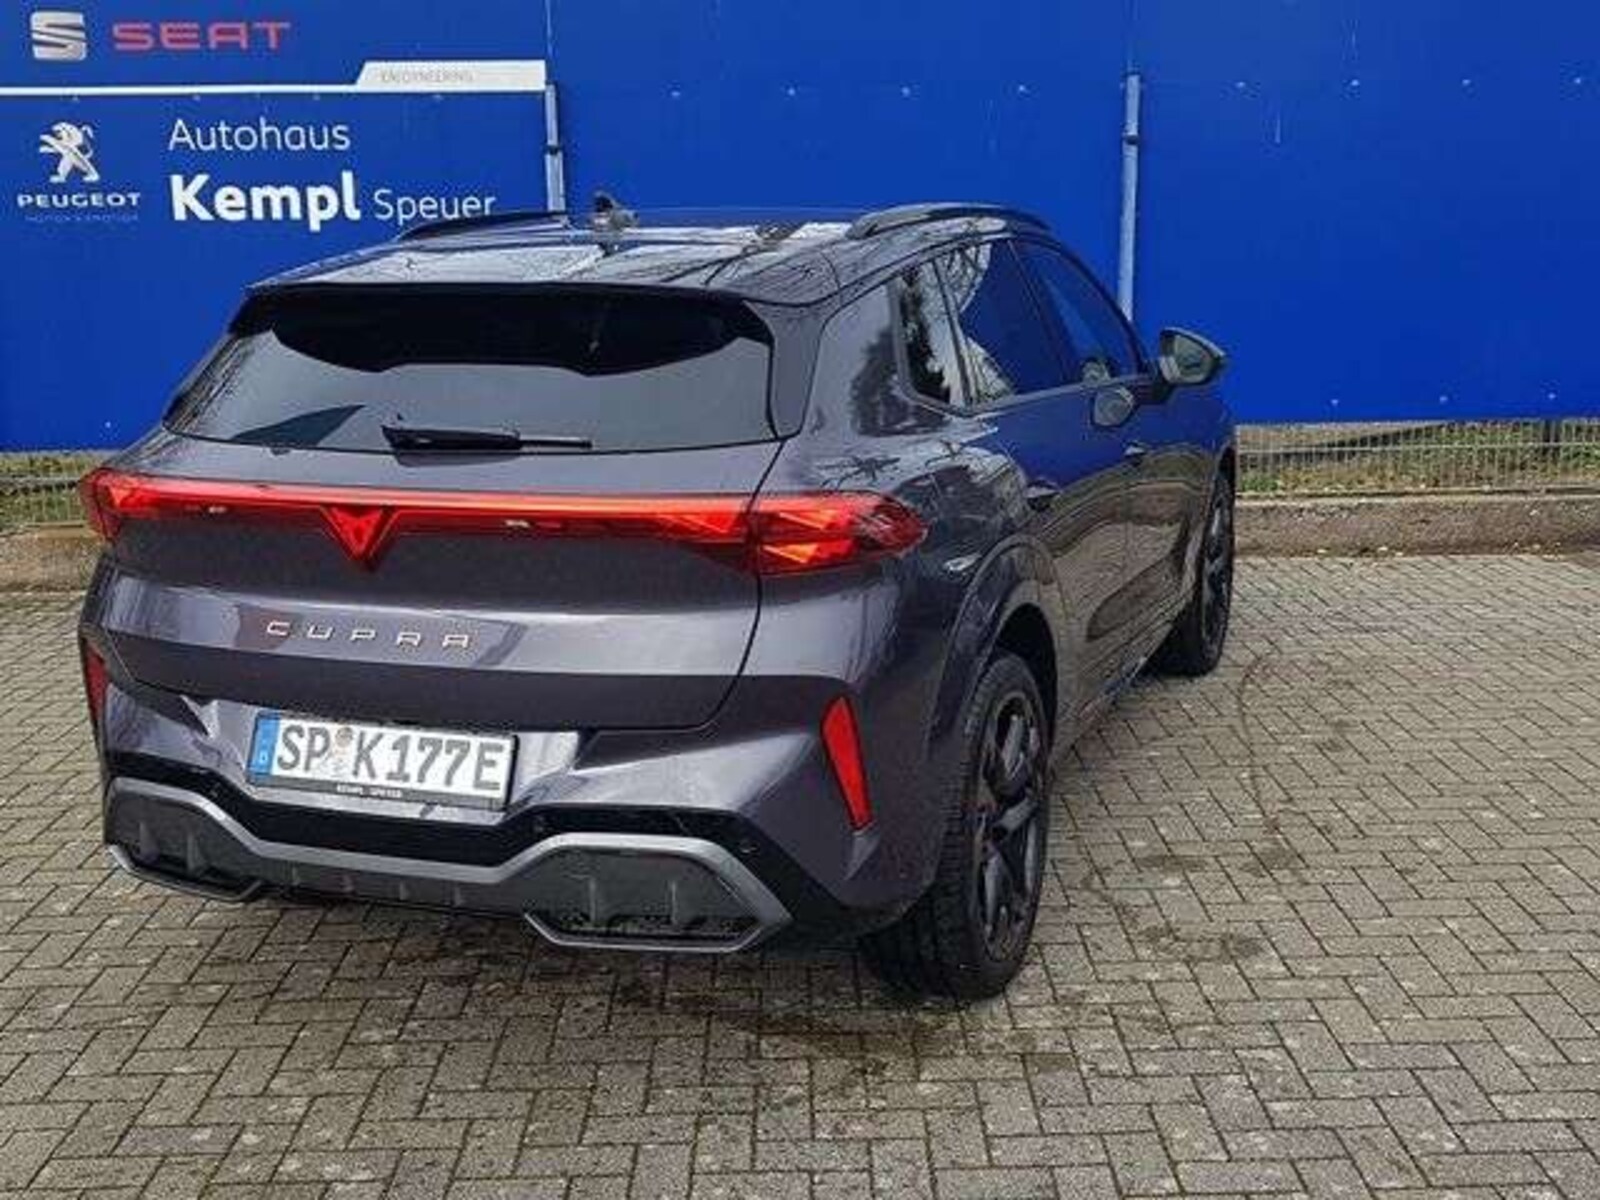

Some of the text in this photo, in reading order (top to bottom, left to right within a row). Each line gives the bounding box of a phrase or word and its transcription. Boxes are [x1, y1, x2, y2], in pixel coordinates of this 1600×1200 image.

[112, 22, 291, 51] SEAT
[168, 116, 351, 152] Autohaus
[17, 192, 141, 208] PEUGEOT
[170, 170, 361, 232] Kempl
[266, 619, 470, 649] CUPRA
[276, 724, 332, 772] SP
